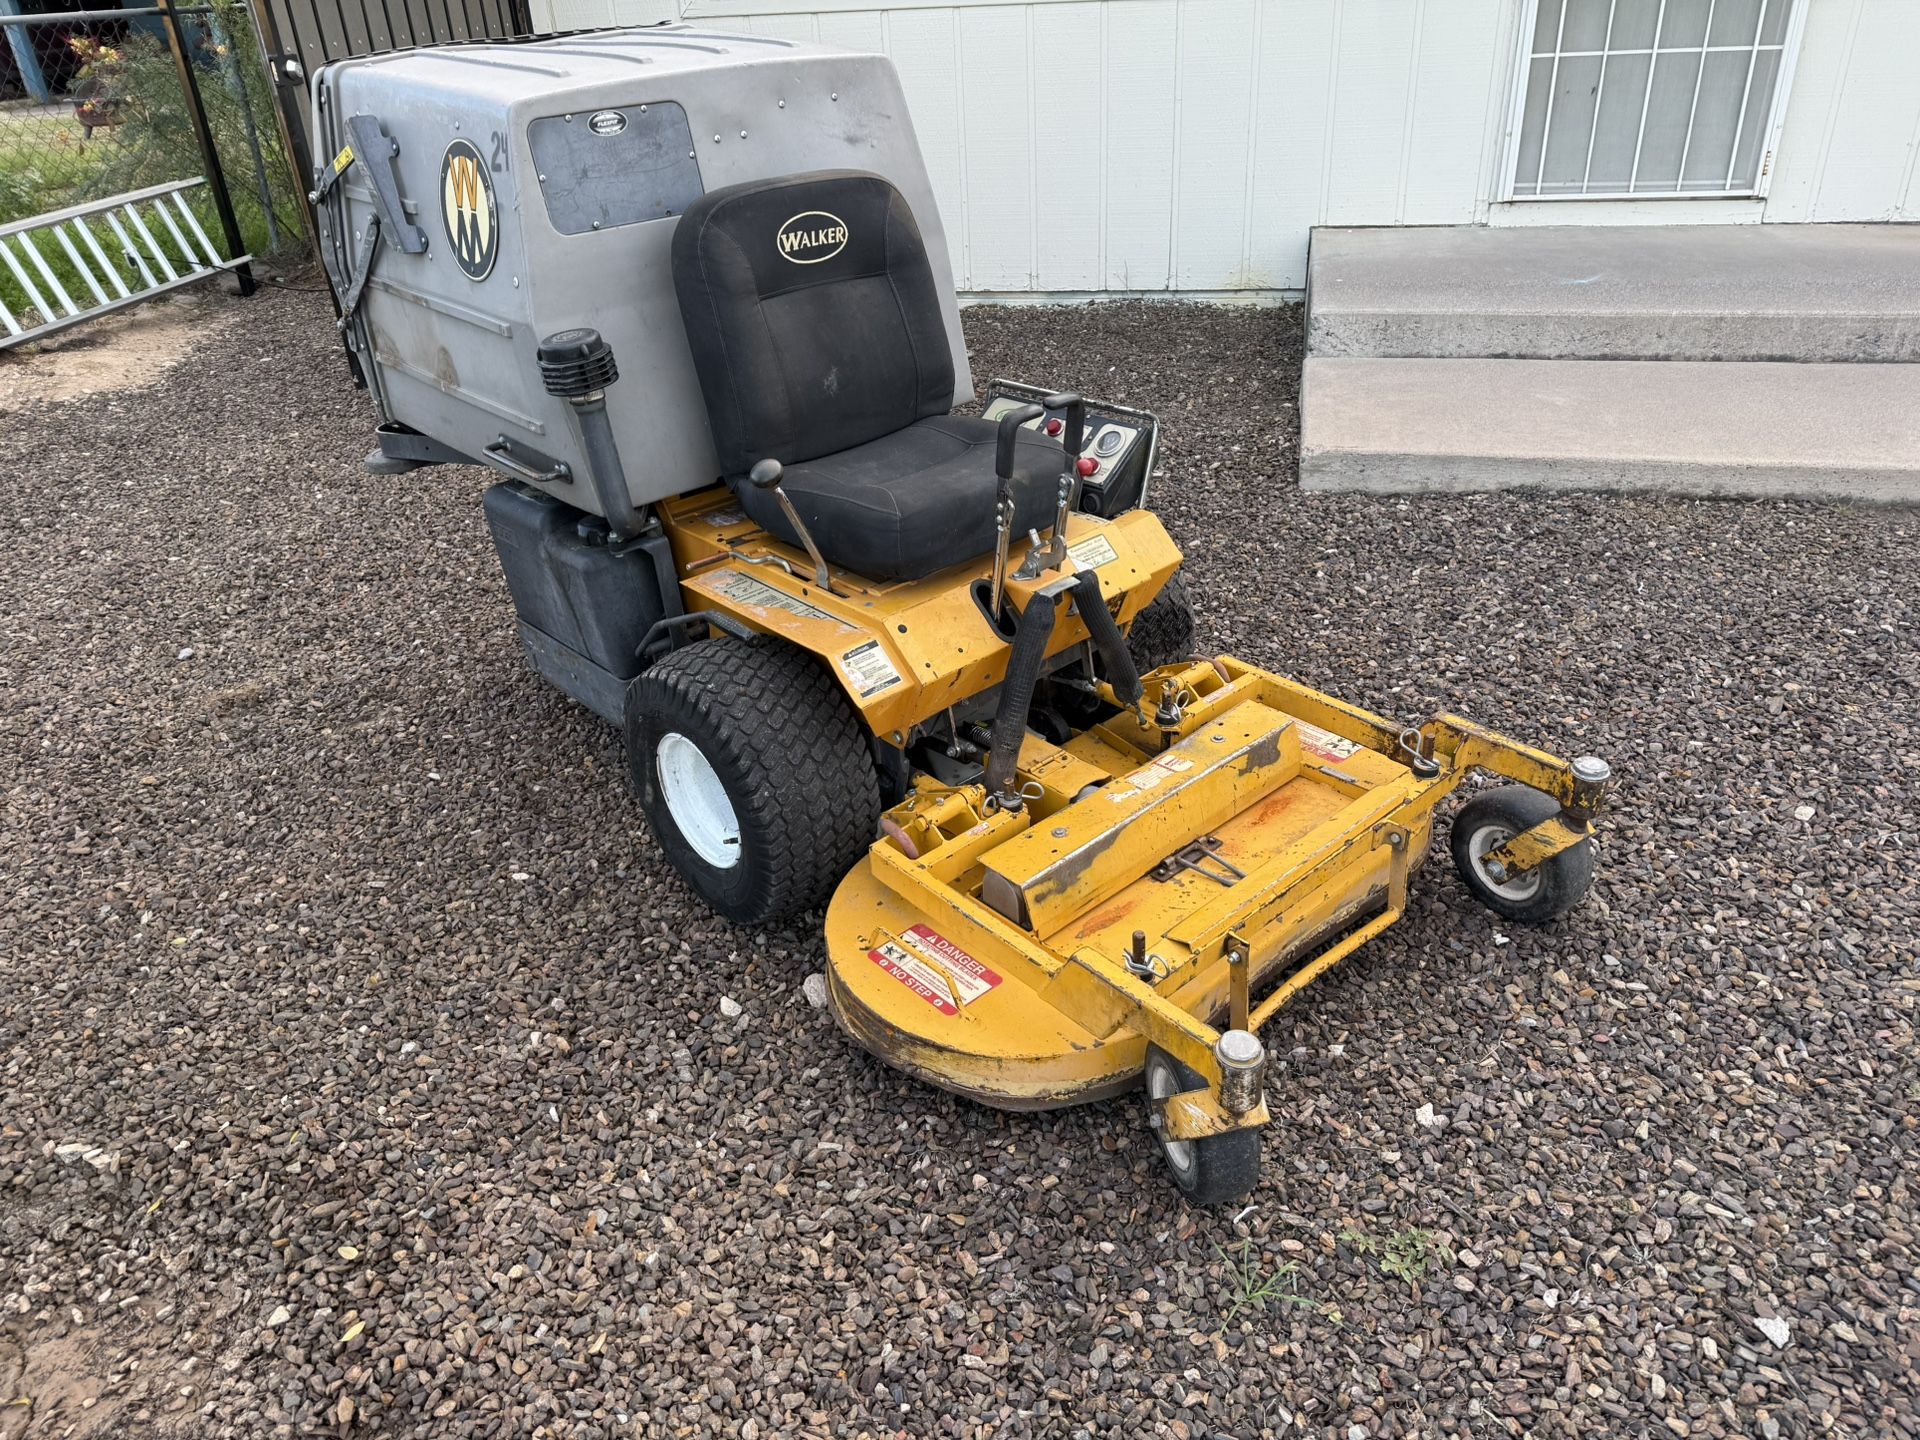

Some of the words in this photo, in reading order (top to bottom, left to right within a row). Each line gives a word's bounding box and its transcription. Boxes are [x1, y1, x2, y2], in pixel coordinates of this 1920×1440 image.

[491, 131, 510, 172] 24
[780, 226, 845, 253] WALKER
[936, 940, 986, 975] DANGER
[889, 967, 906, 980] NO
[905, 977, 932, 997] STEP
